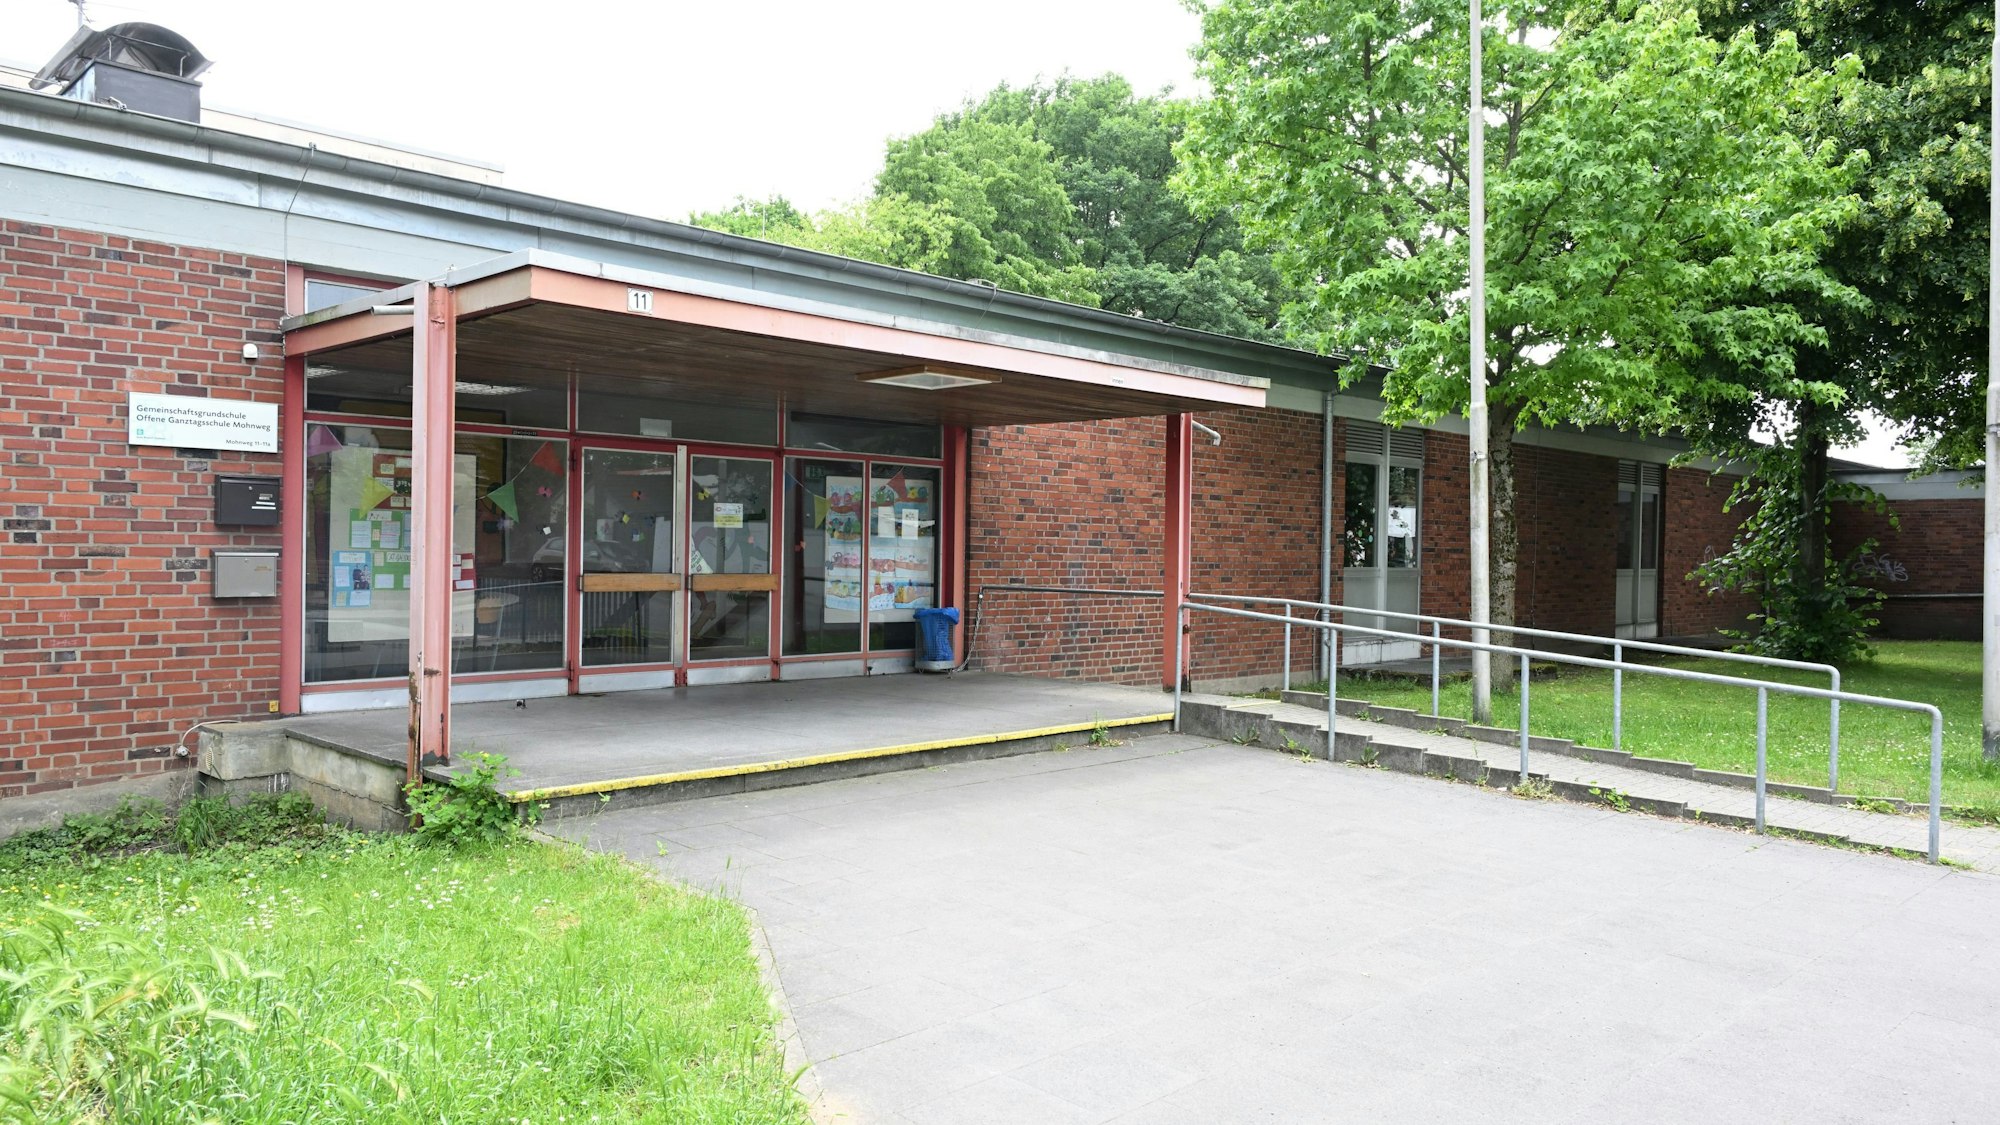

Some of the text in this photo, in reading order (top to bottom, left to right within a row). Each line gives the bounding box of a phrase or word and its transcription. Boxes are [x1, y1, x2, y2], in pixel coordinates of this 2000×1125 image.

[634, 292, 647, 310] 11
[136, 404, 247, 419] Gemeinschaftsgrundschule
[136, 414, 271, 432] Offene Ganztagsschule Mohnweg
[225, 439, 254, 447] Mohnweg
